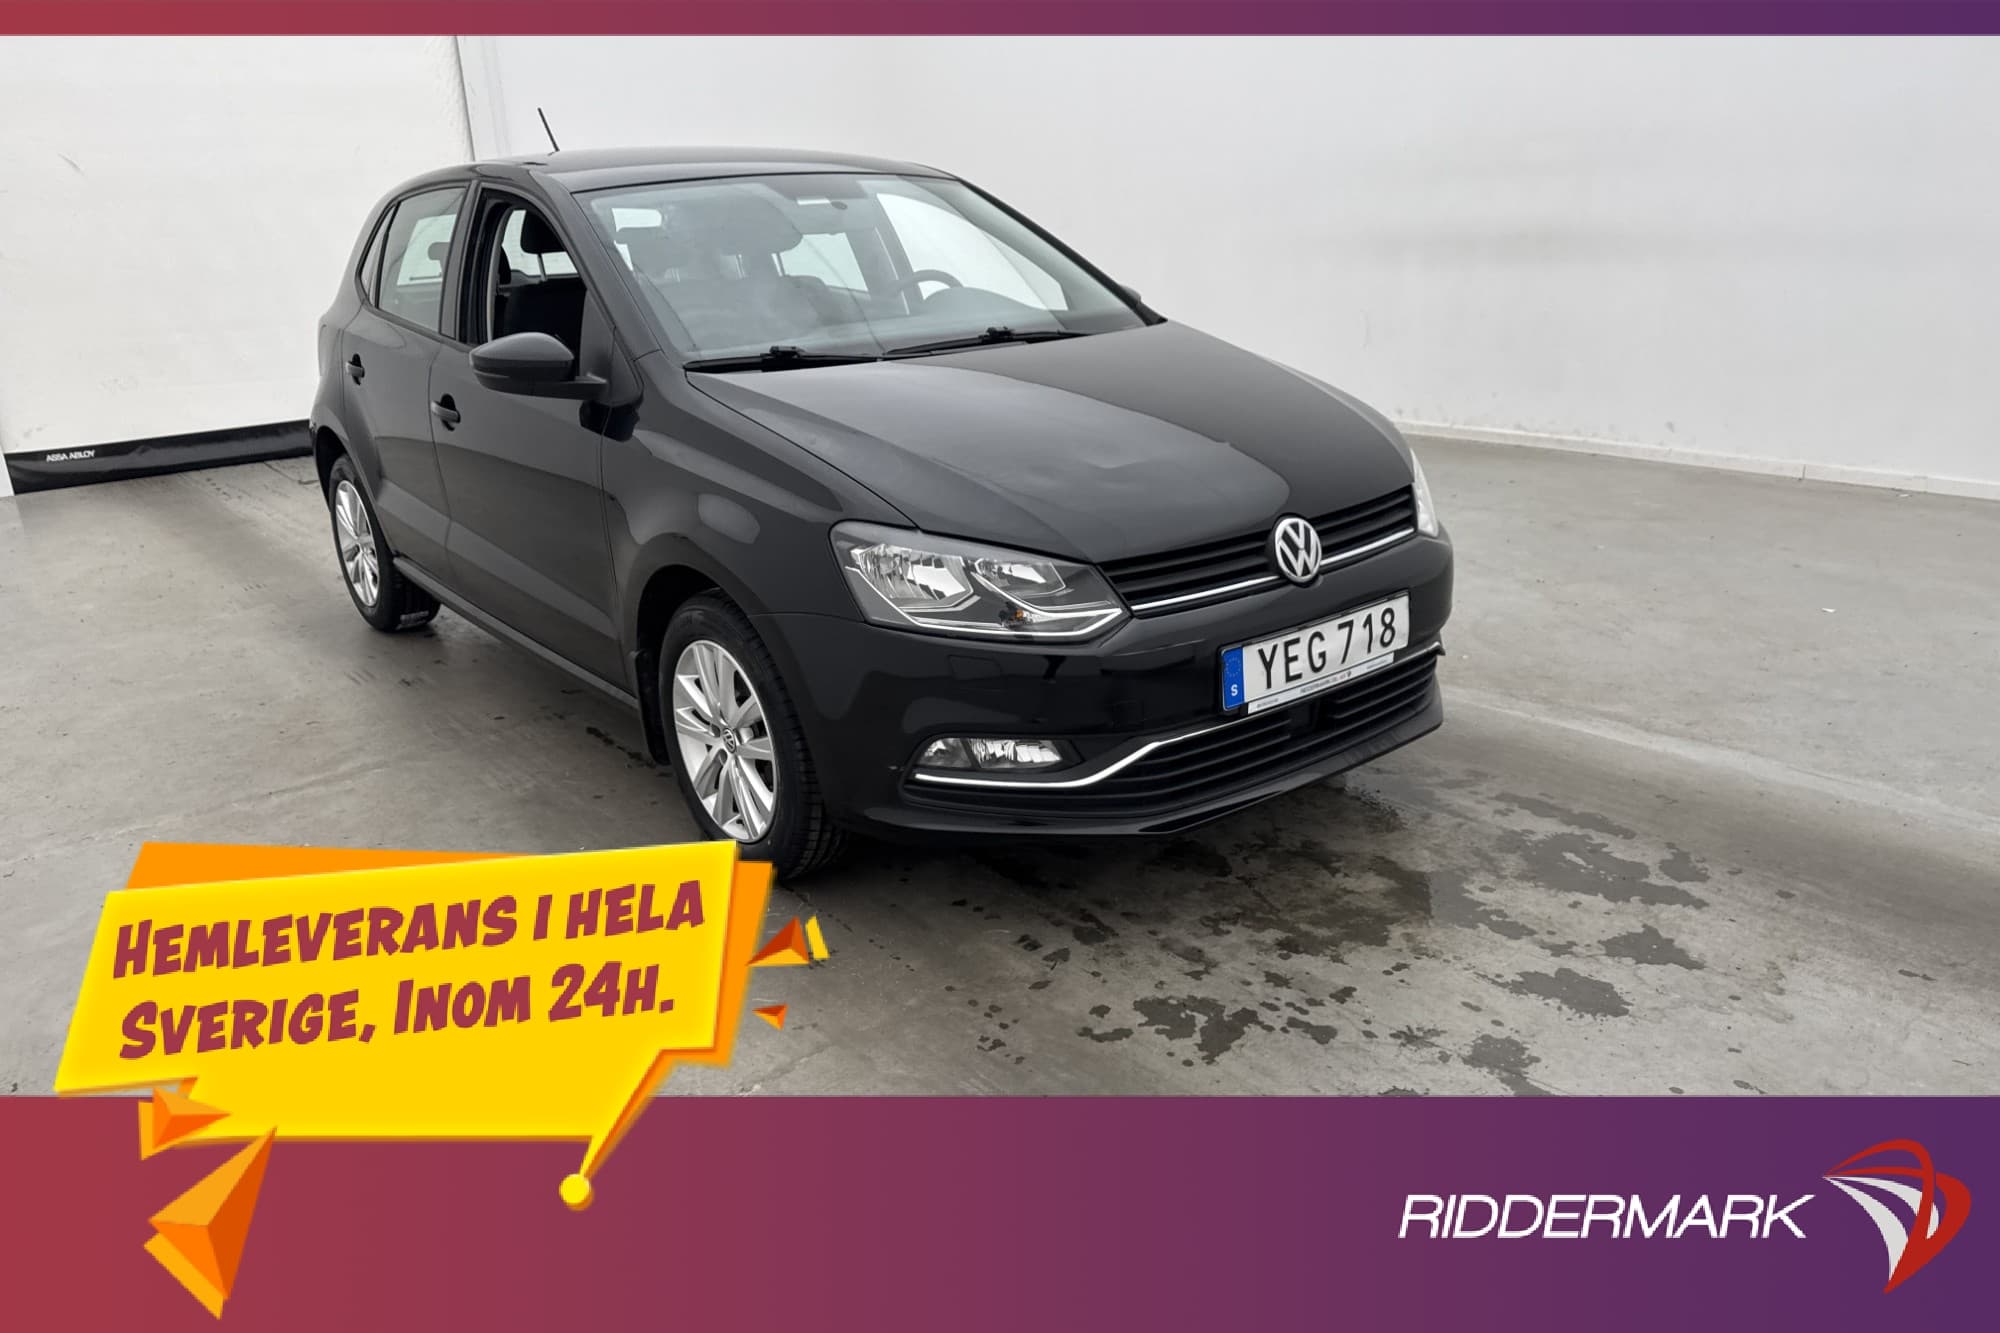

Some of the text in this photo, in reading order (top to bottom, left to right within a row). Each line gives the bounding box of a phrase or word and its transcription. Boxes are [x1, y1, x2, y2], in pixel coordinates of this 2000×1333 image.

[1257, 606, 1397, 690] YEG 718
[1230, 684, 1239, 697] S
